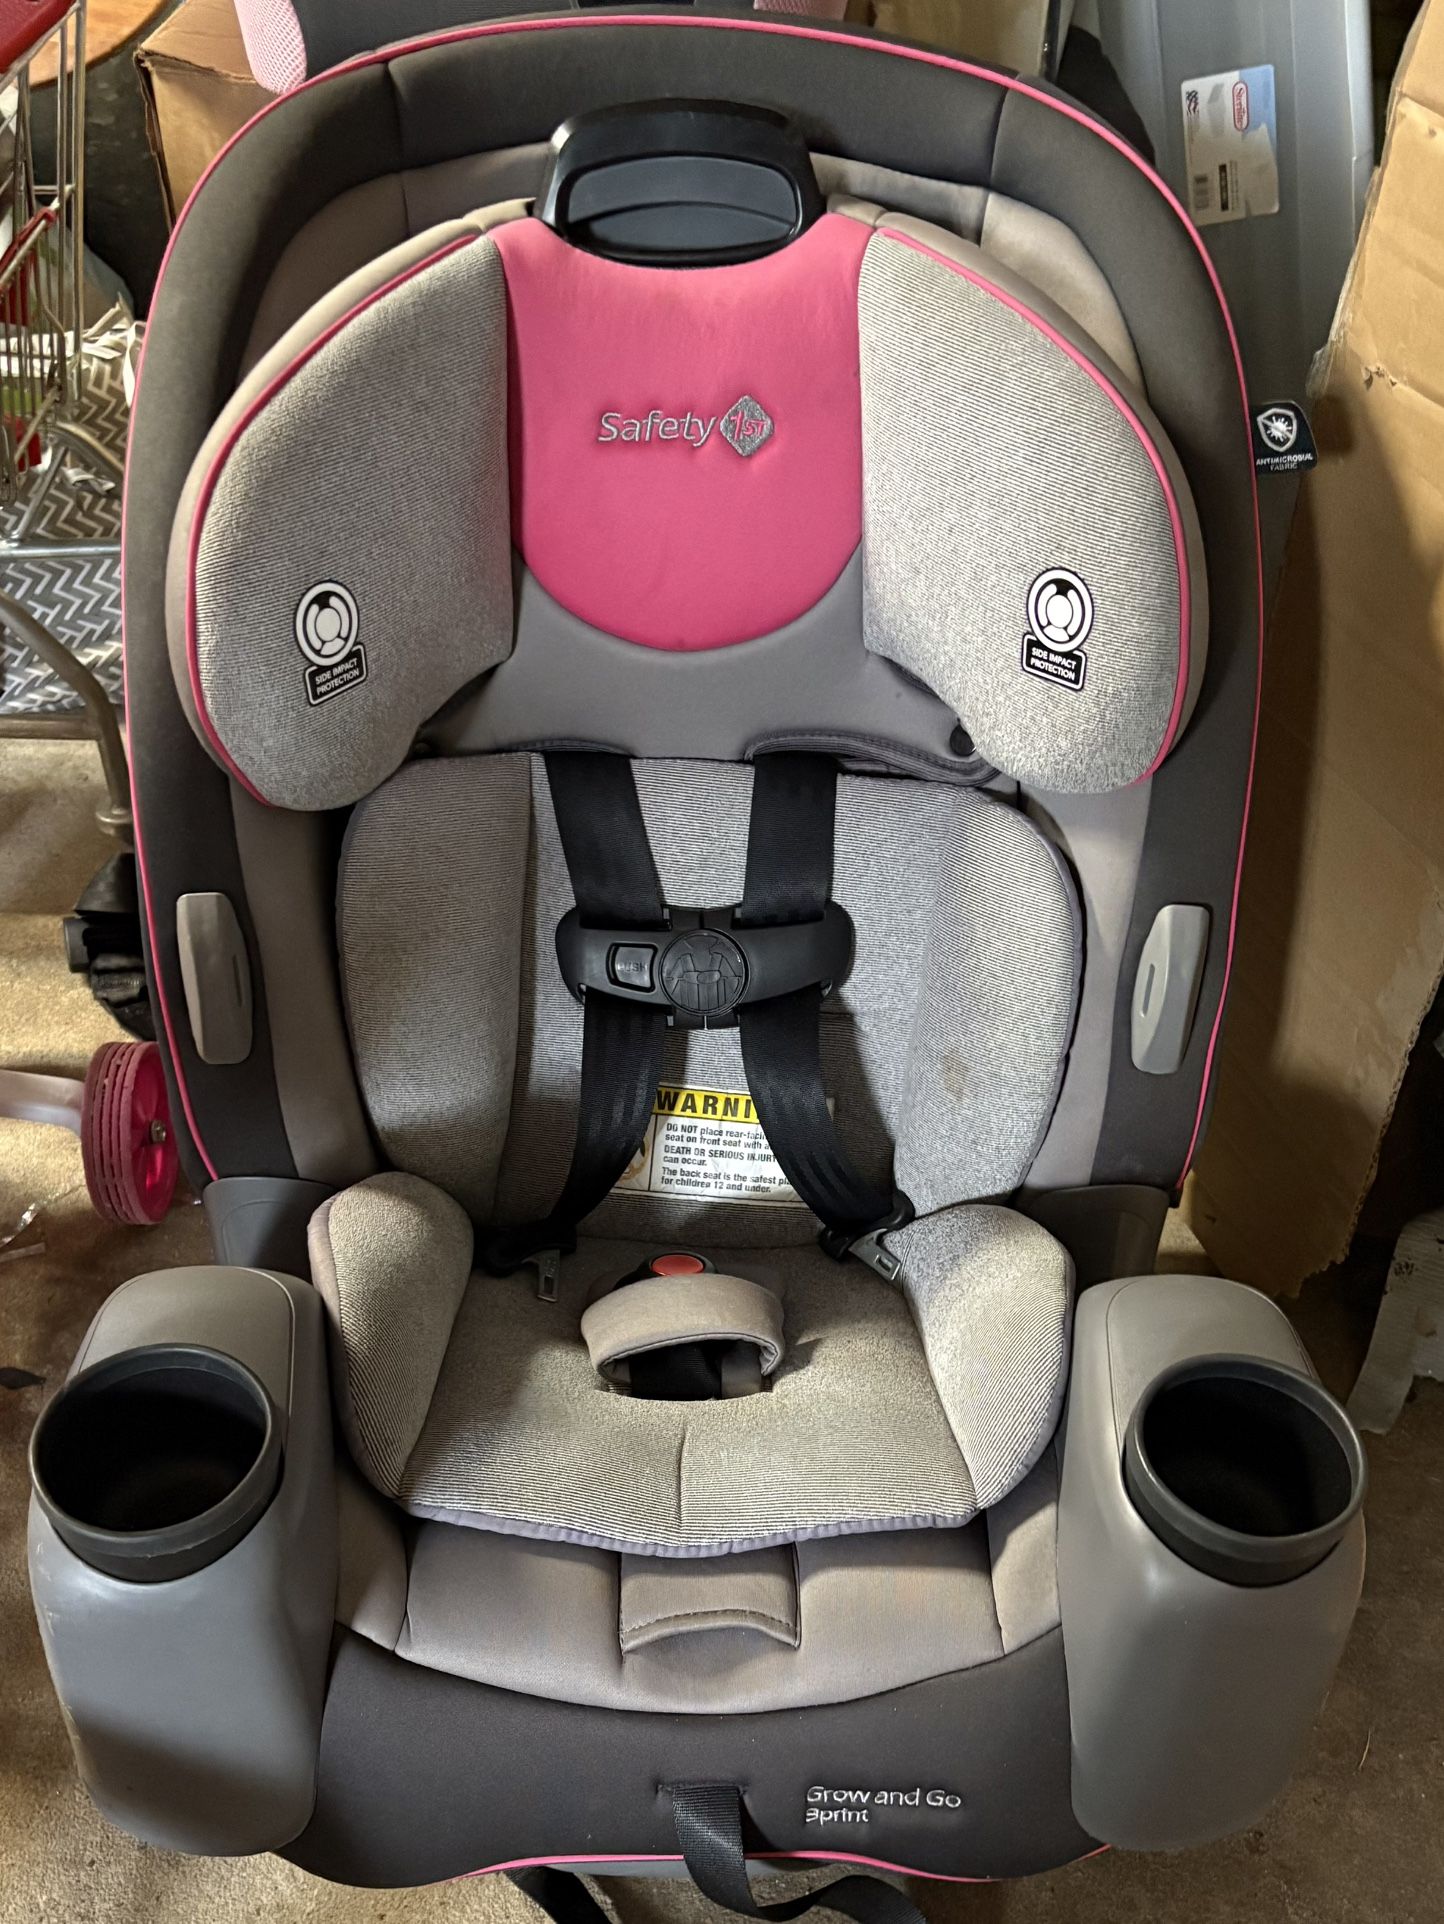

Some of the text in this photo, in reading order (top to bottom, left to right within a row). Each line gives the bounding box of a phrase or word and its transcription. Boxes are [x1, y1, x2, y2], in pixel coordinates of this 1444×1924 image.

[598, 410, 716, 447] Safety
[1256, 453, 1313, 465] ANTIMICROBIAL
[1270, 463, 1297, 471] FABRIC
[1031, 647, 1077, 670] SIDE IMPACT
[315, 657, 358, 685] SIDE IMPACT
[1030, 656, 1076, 681] PROTECTION
[316, 667, 359, 696] PROTECTION
[616, 961, 648, 972] PUSH
[656, 1090, 752, 1119] WARNI
[666, 1122, 678, 1132] DO
[680, 1124, 698, 1134] NOT
[700, 1126, 724, 1138] place
[665, 1133, 684, 1142] seat
[686, 1135, 697, 1143] on
[700, 1135, 720, 1146] front
[722, 1139, 741, 1147] seat
[743, 1141, 762, 1149] with
[663, 1156, 707, 1166] can occur.
[664, 1144, 691, 1155] DEATH
[693, 1147, 706, 1157] OR
[708, 1149, 744, 1160] SERIOUS
[661, 1166, 678, 1176] The
[680, 1168, 701, 1178] back
[703, 1172, 721, 1180] seat
[723, 1172, 731, 1180] is
[733, 1173, 748, 1182] the
[750, 1174, 776, 1185] safest
[661, 1176, 771, 1193] for children 12 and under.
[807, 1786, 962, 1808] Grow and Go
[805, 1807, 869, 1825] Sprint
